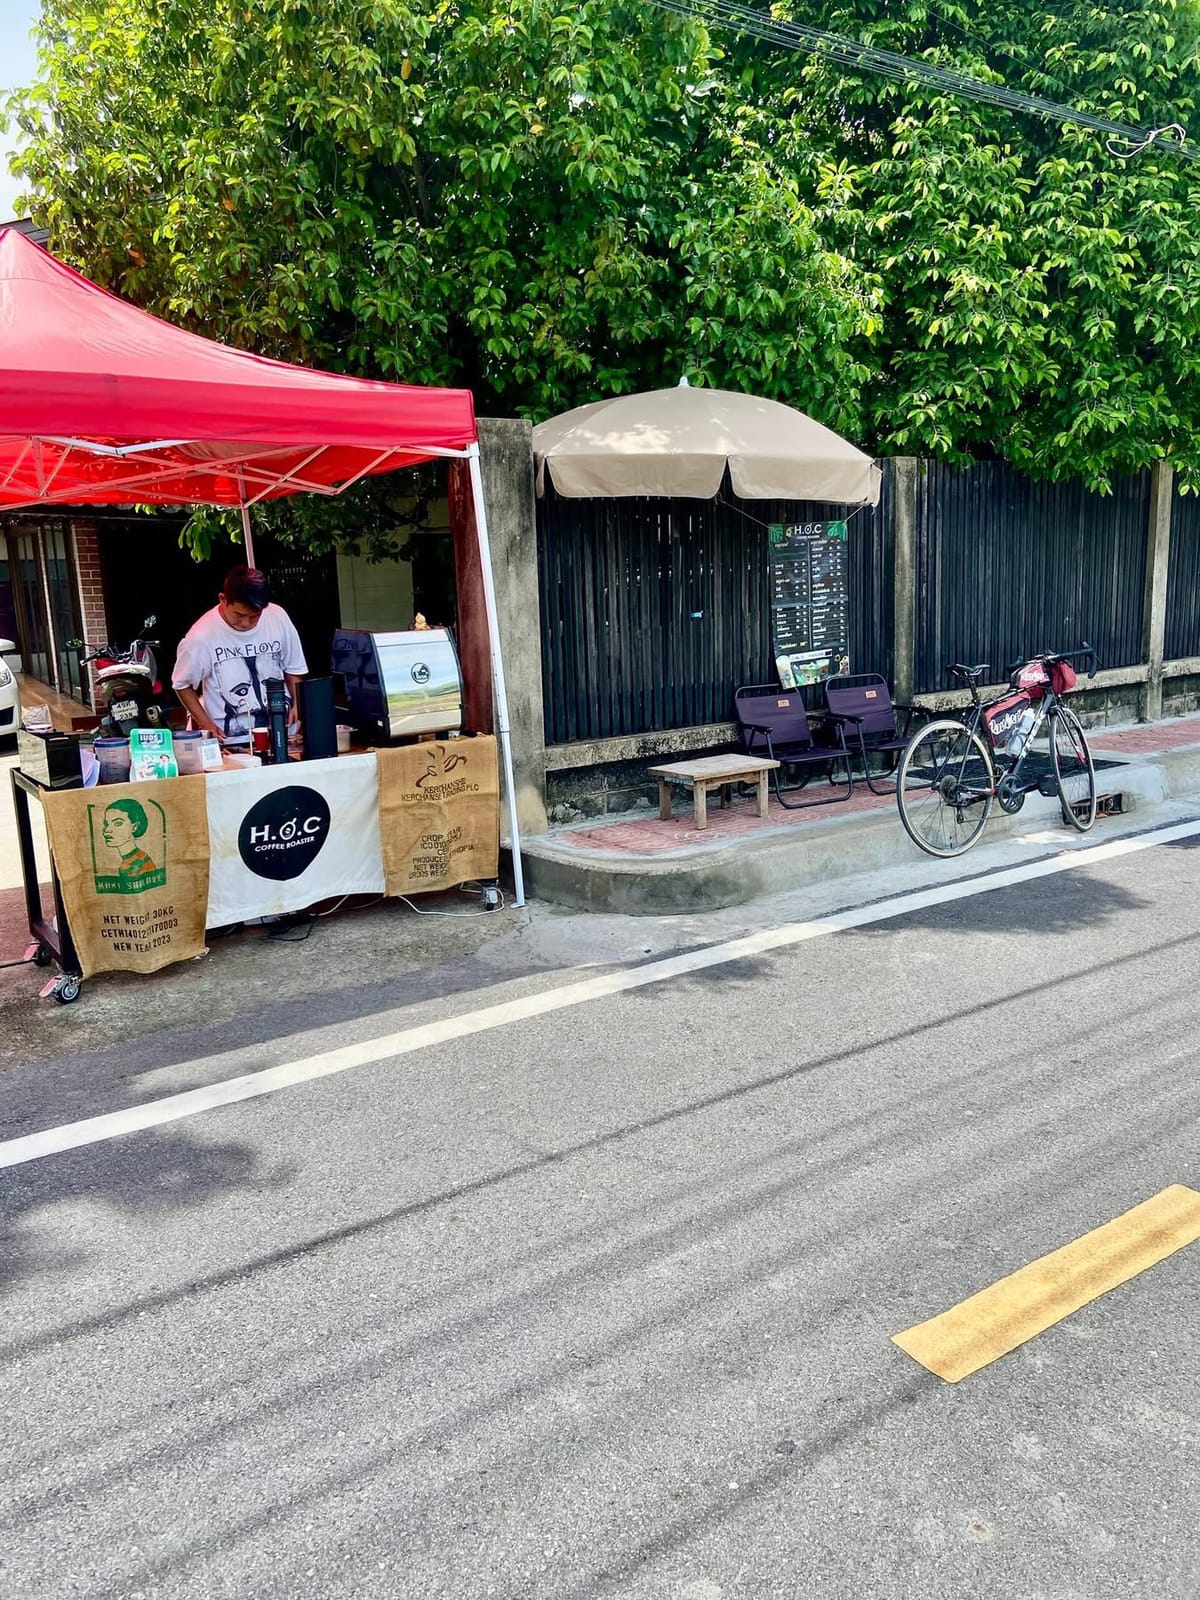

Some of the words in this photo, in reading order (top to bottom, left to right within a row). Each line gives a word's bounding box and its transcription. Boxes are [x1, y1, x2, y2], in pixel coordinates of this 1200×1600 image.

[794, 523, 822, 535] H.O.C
[215, 647, 243, 660] PINK
[245, 641, 281, 656] FLOYD
[250, 816, 321, 844] H.O.C
[421, 834, 443, 842] CROP
[254, 843, 285, 852] COFFEE
[286, 836, 315, 849] ROASTER
[103, 915, 120, 925] NET
[152, 905, 175, 919] 30KG
[113, 942, 132, 952] NEW
[152, 934, 171, 948] 2023
